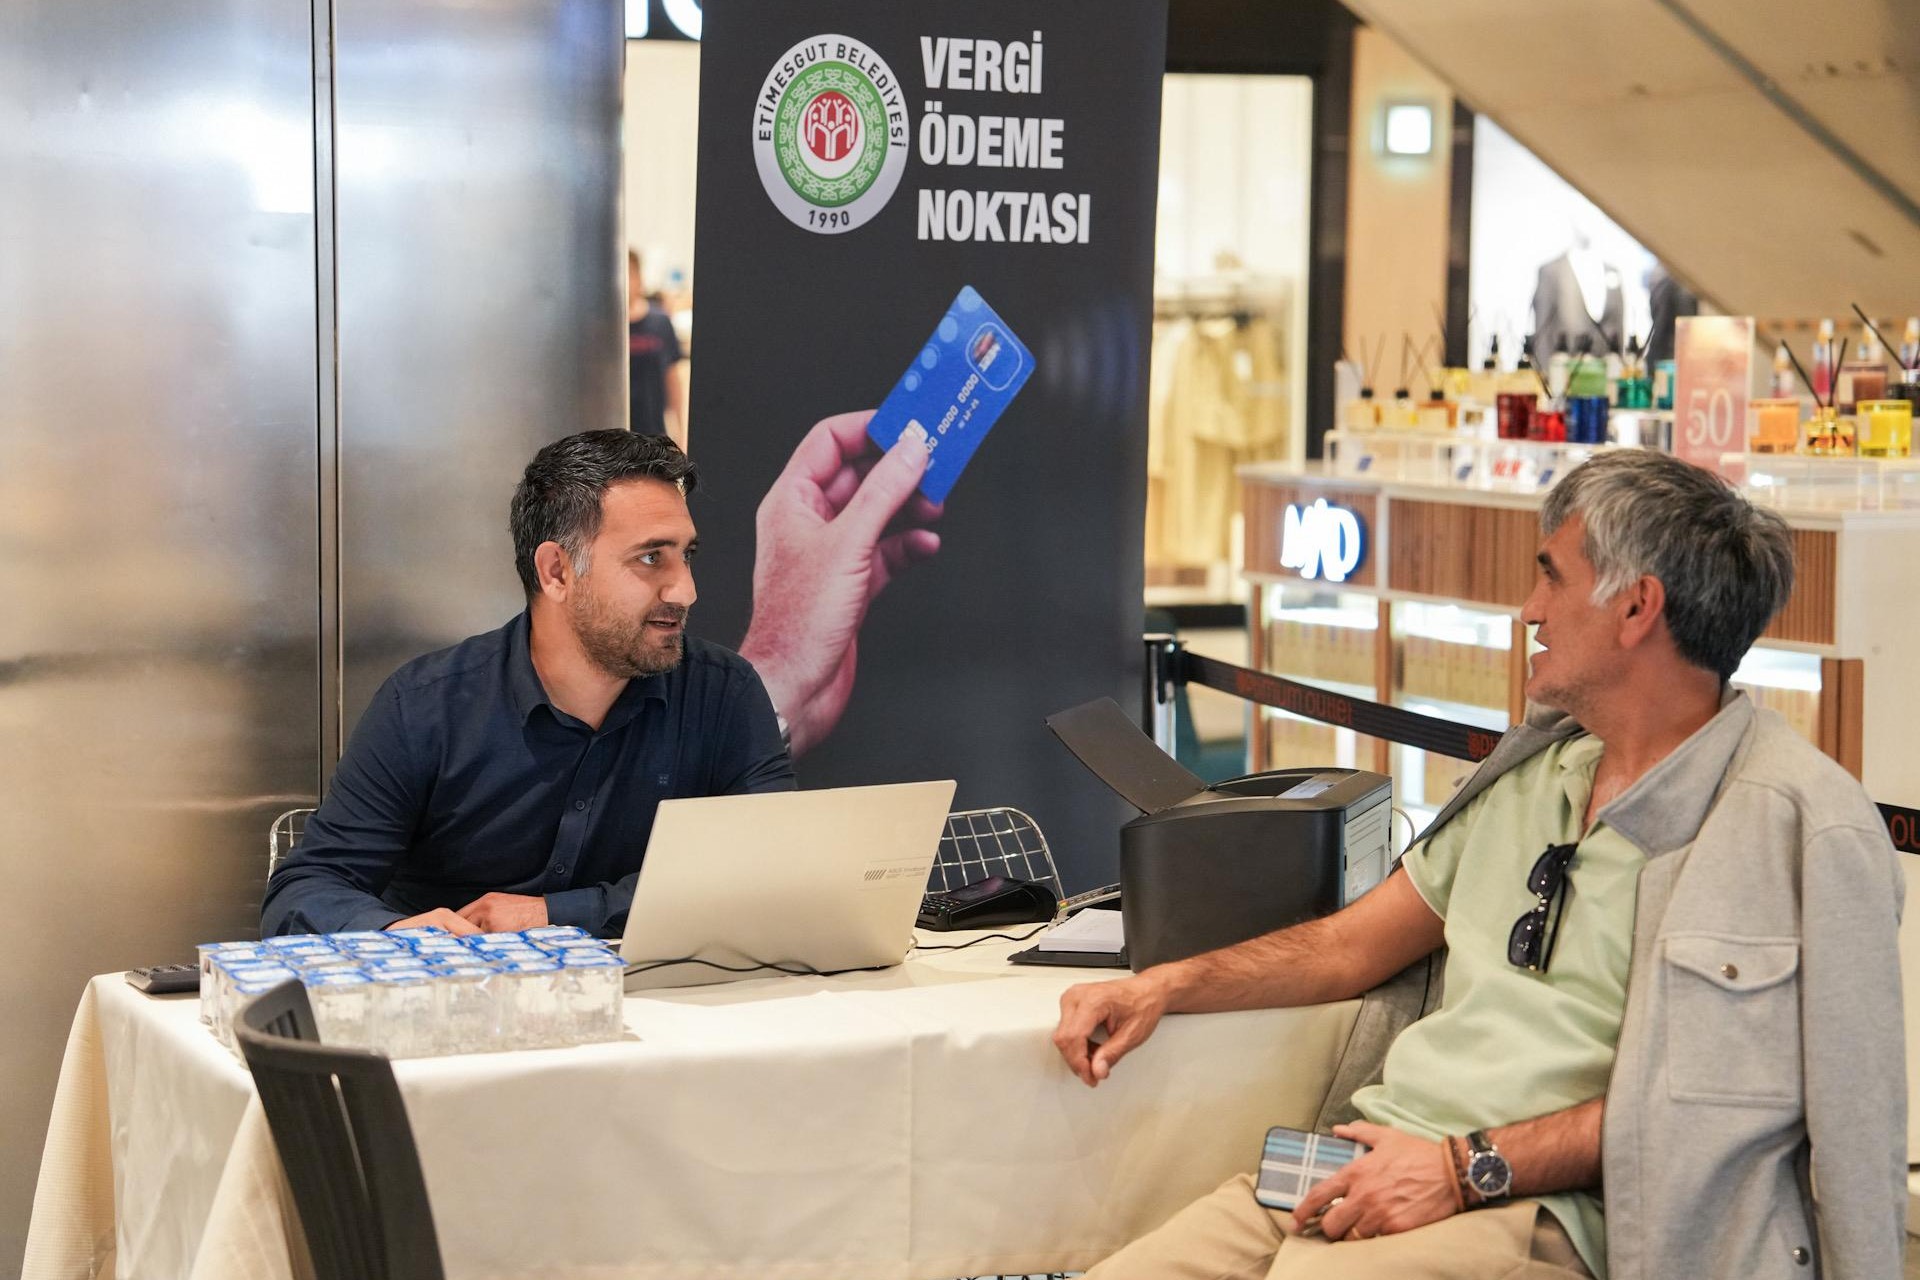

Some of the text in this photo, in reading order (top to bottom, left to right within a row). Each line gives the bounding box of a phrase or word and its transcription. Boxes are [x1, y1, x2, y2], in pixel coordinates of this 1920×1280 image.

[920, 30, 1043, 94] VERGİ
[759, 42, 906, 147] ETİMESGUT BELEDİYESİ
[918, 101, 1064, 169] ÖDEME
[808, 210, 850, 228] 1990
[917, 189, 1090, 244] NOKTASI
[1686, 388, 1734, 446] 50
